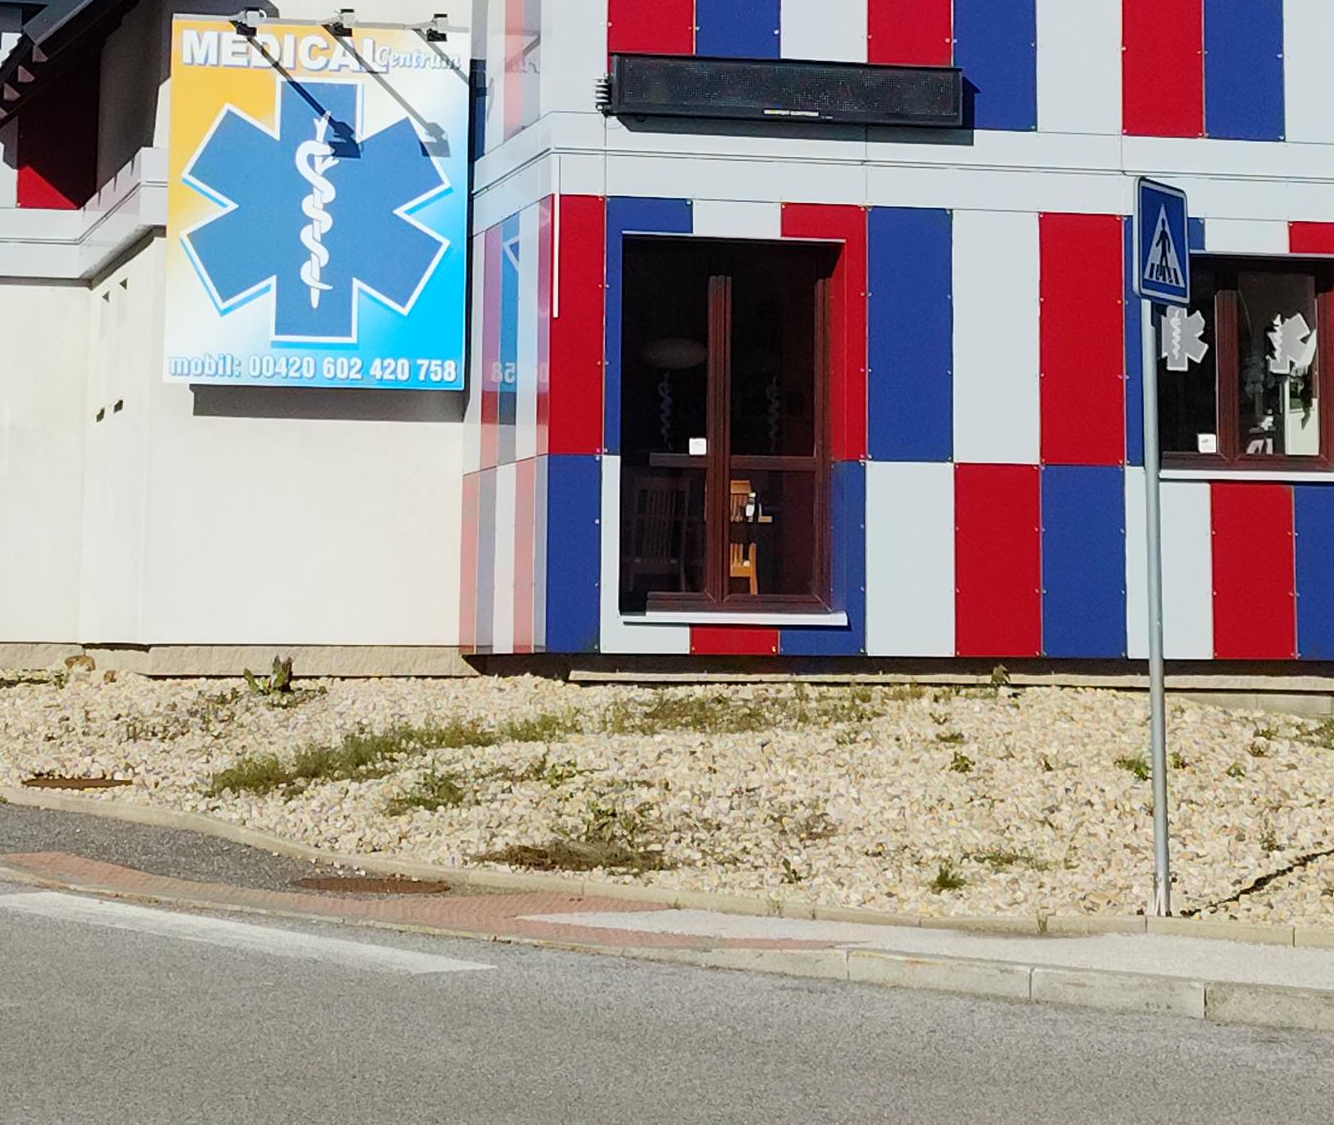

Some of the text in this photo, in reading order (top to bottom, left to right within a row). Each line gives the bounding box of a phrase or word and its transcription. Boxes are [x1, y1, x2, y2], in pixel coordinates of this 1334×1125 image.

[181, 29, 462, 74] MEDICAL Centrum
[169, 352, 458, 383] mobil: 00420 602 420 758
